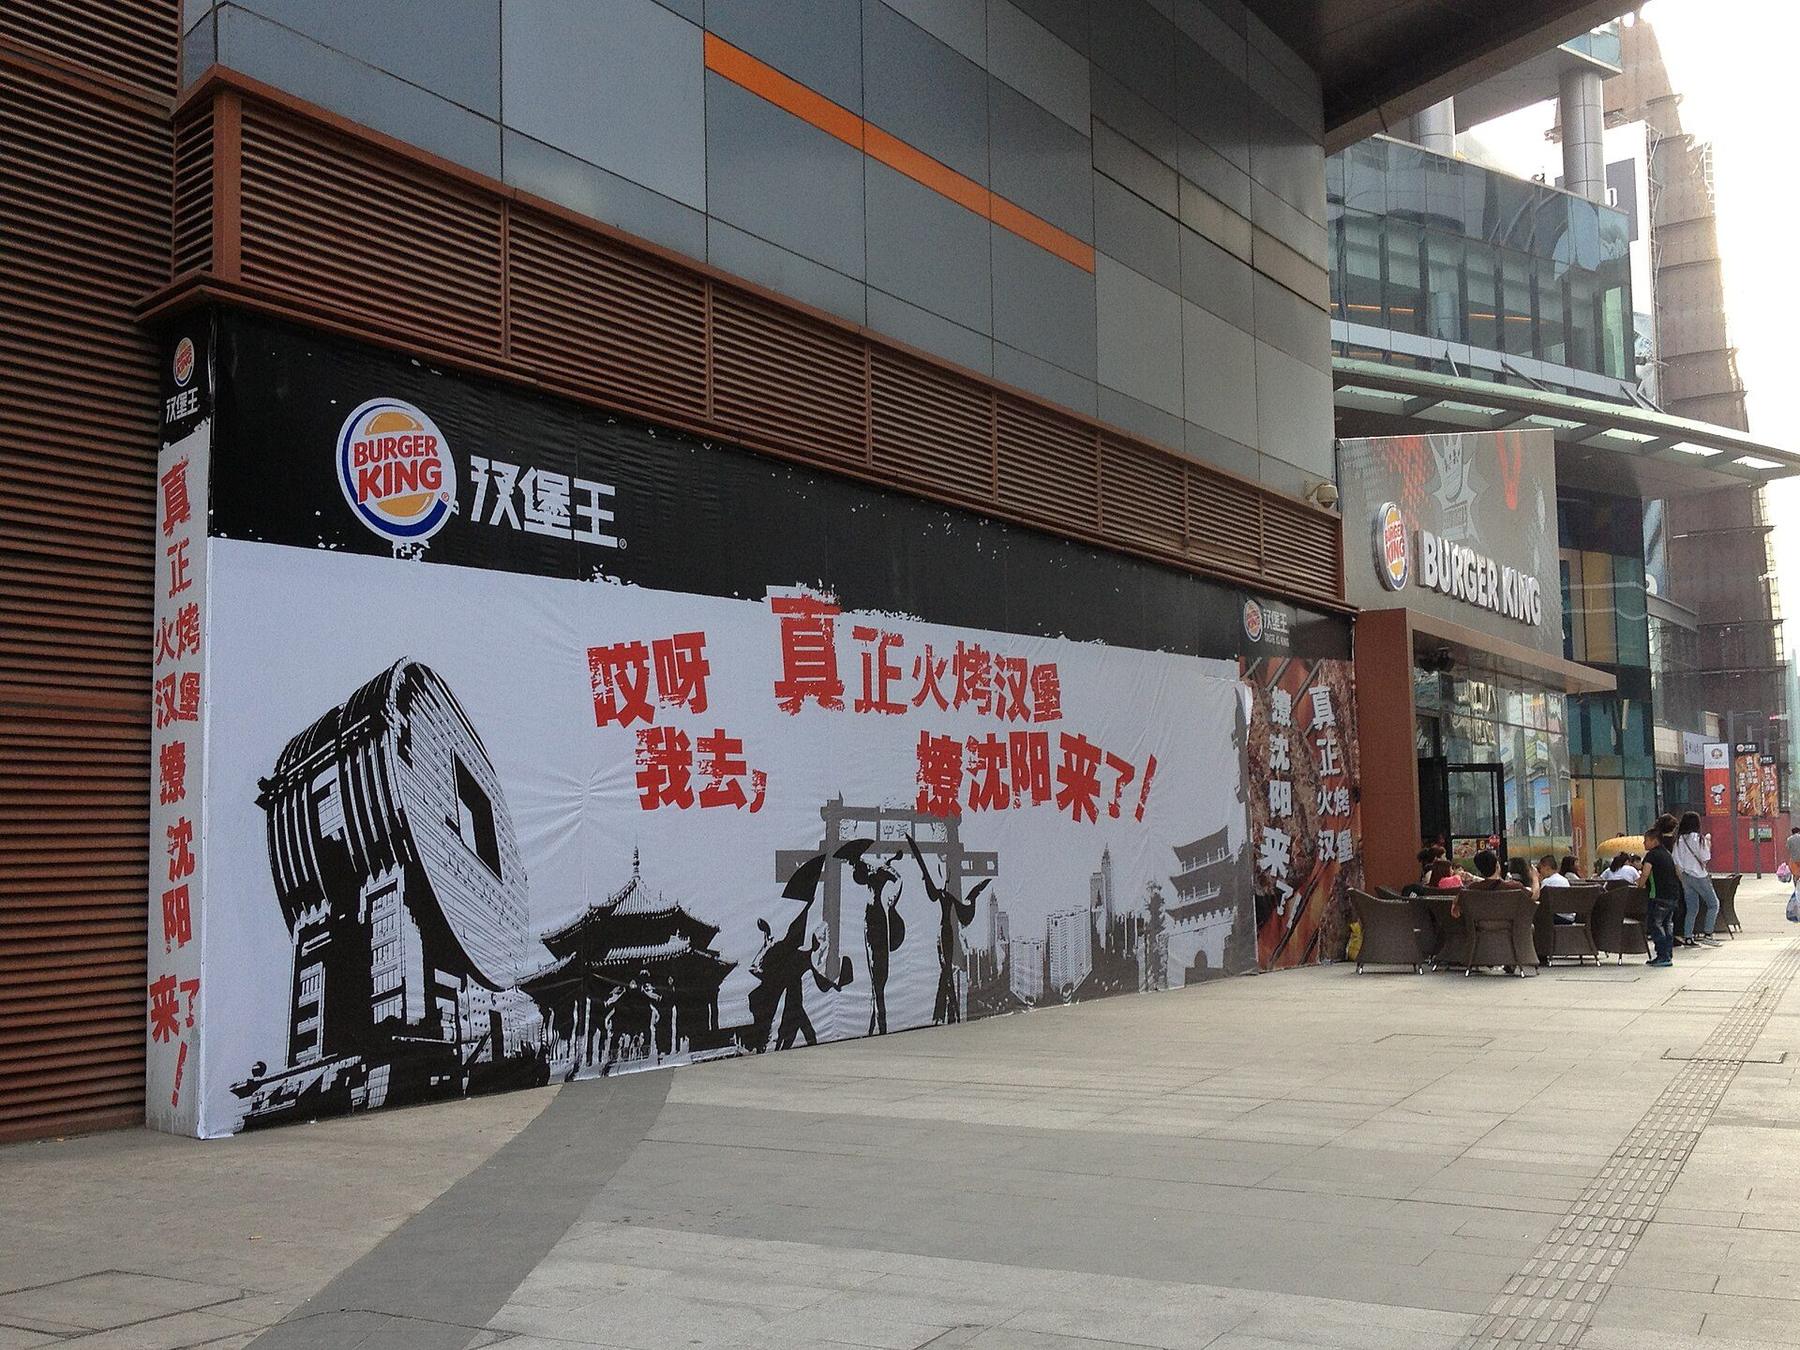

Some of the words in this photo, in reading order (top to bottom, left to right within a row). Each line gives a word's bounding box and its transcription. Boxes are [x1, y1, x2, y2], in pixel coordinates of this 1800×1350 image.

[166, 387, 199, 424] 汉堡王
[353, 434, 439, 468] BURGER
[358, 457, 442, 504] KING
[470, 454, 618, 549] 汉堡王
[1420, 529, 1500, 612] BURGER
[1501, 563, 1542, 627] KING
[587, 631, 711, 728] 哎呀
[771, 594, 1063, 723] 真正火烤汉堡
[1308, 684, 1354, 864] 真正火烤汉堡
